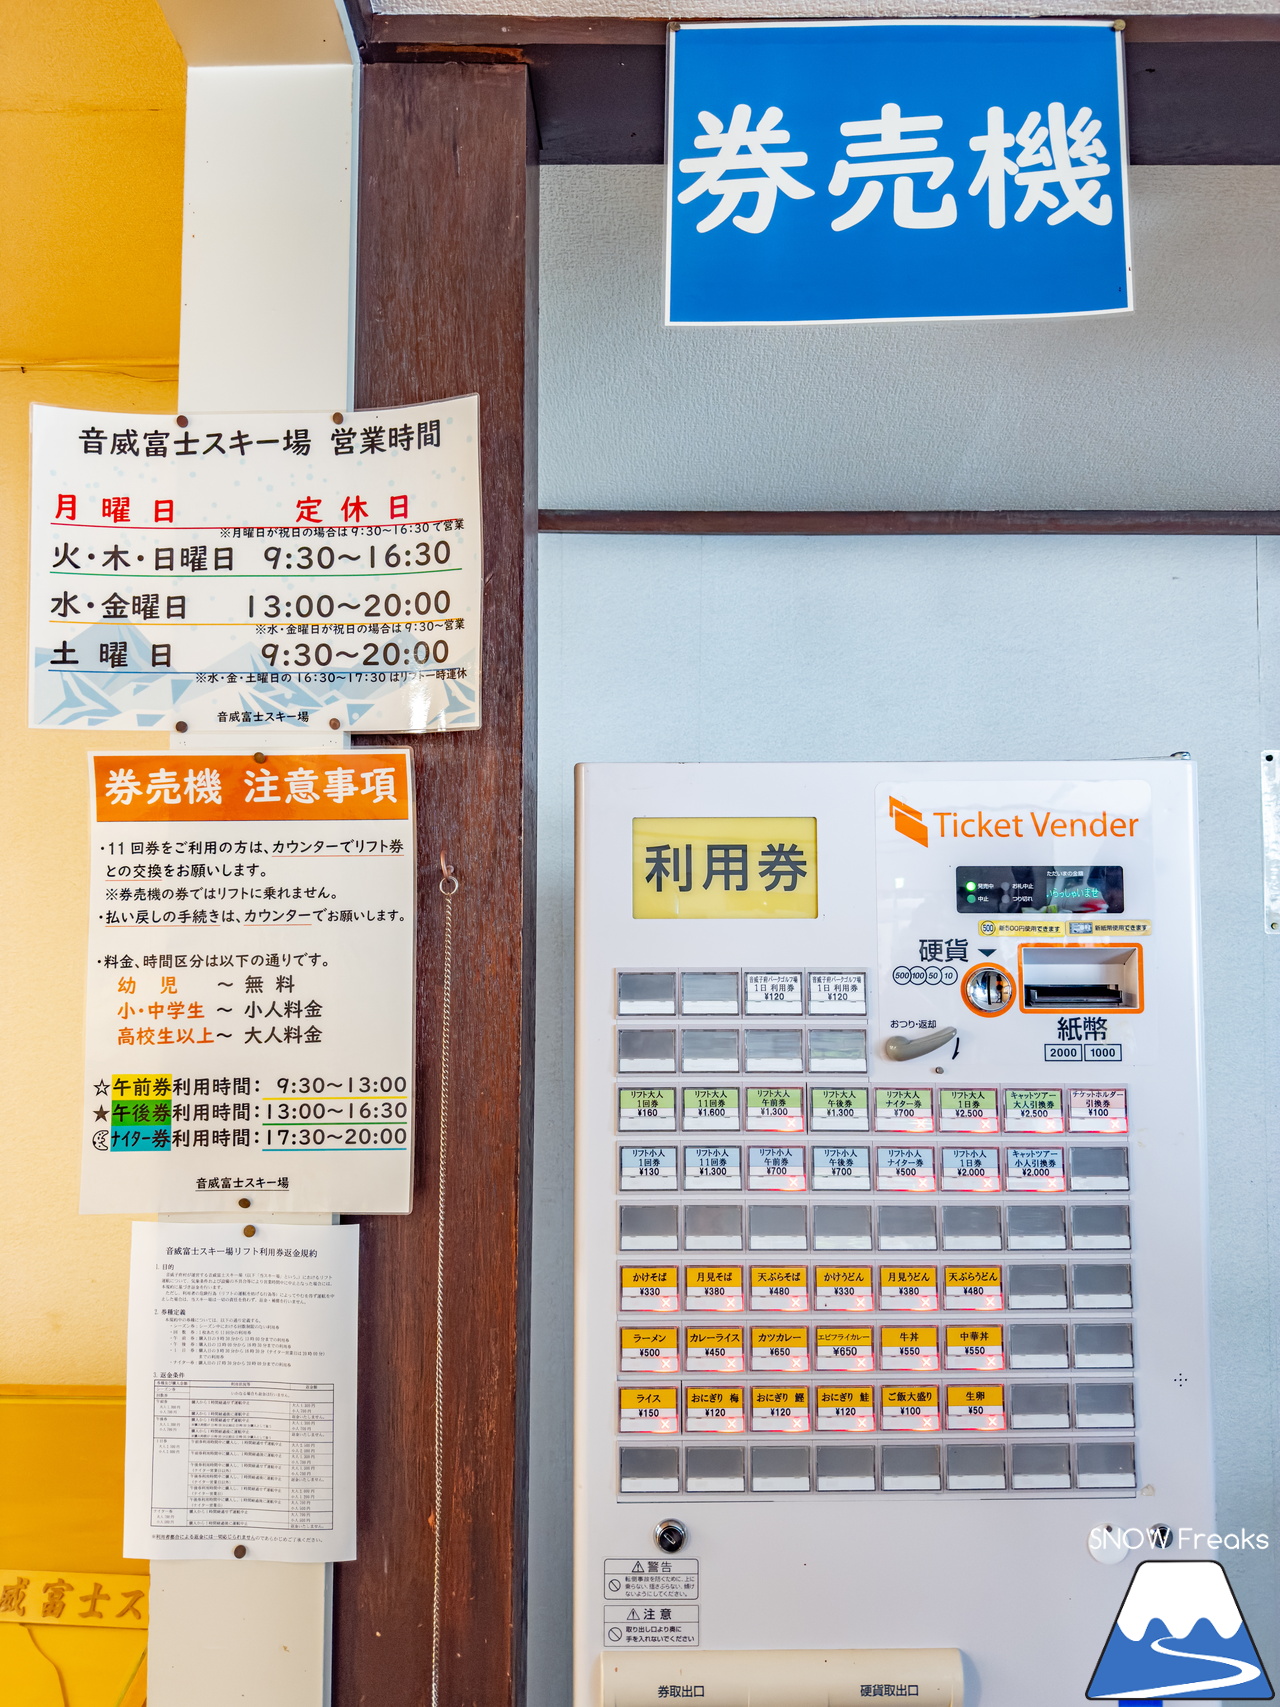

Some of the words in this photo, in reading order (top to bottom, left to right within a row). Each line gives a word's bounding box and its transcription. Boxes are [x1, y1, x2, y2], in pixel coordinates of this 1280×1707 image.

[678, 102, 1112, 233] 券売機
[79, 426, 311, 457] 音威富士スキー場
[331, 419, 441, 456] 営業時間
[248, 590, 451, 618] 13:00～20:00
[217, 711, 309, 723] 音威富士スキー場
[105, 767, 222, 805] 券売機
[243, 767, 398, 804] 注意事項
[933, 811, 1023, 837] Ticket
[1030, 811, 1139, 837] Vender
[105, 864, 267, 878] との交換をお願いします。
[645, 843, 807, 892] 利用券
[919, 938, 968, 962] 硬貨
[765, 993, 784, 1001] ¥120
[828, 993, 847, 1001] ¥120
[244, 999, 323, 1018] 小人料金
[1057, 1016, 1108, 1041] 紙幣
[244, 1025, 323, 1044] 大人料金
[1050, 1048, 1077, 1057] 2000
[1091, 1048, 1116, 1057] 1000
[631, 1091, 663, 1099] リフト大人
[695, 1091, 727, 1099] リフト大人
[757, 1090, 790, 1098] リフト大人
[823, 1090, 856, 1098] リフト大人
[886, 1091, 920, 1099] リフト大人
[952, 1091, 984, 1099] リフト大人
[1072, 1091, 1123, 1099] チケットホルダー
[638, 1099, 658, 1107] 1回券
[699, 1099, 722, 1107] 11回券
[762, 1099, 785, 1107] 午前券
[828, 1099, 852, 1107] 午後券
[886, 1100, 921, 1108] ナイター券
[959, 1100, 980, 1108] 1日券
[1013, 1100, 1054, 1109] 大人引換券
[1086, 1099, 1110, 1107] 引換券
[638, 1108, 657, 1116] ¥160
[894, 1109, 914, 1117] ¥700
[1089, 1108, 1108, 1116] ¥100
[633, 1149, 665, 1157] リフト小人
[696, 1149, 729, 1157] リフト小人
[759, 1149, 792, 1157] リフト小人
[824, 1149, 857, 1157] リフト小人
[889, 1150, 921, 1158] リフト小人
[954, 1150, 986, 1158] リフト小人
[1013, 1150, 1057, 1158] キャットツアー
[639, 1158, 660, 1166] 1回券
[700, 1158, 723, 1166] 11回券
[764, 1157, 788, 1165] 午前券
[829, 1158, 853, 1166] 午後券
[888, 1159, 923, 1167] ナイター券
[960, 1159, 982, 1167] 1日券
[1015, 1159, 1056, 1167] 小人引換券
[640, 1167, 659, 1175] ¥130
[832, 1167, 852, 1175] ¥700
[896, 1168, 916, 1176] ¥500
[195, 1177, 289, 1189] 音威富士スキー場
[633, 1272, 667, 1282] かけそば
[697, 1272, 732, 1282] 月見そば
[824, 1272, 864, 1282] かけうどん
[888, 1272, 930, 1282] 月見うどん
[640, 1288, 660, 1296] ¥330
[705, 1288, 725, 1296] ¥380
[769, 1288, 789, 1296] ¥480
[834, 1287, 854, 1295] ¥330
[899, 1287, 919, 1295] ¥380
[964, 1287, 983, 1295] ¥480
[633, 1333, 666, 1343] ラーメン
[690, 1333, 740, 1343] カレーライス
[758, 1333, 801, 1343] カツカレー
[900, 1332, 918, 1341] 牛丼
[960, 1332, 988, 1341] 中華丼
[640, 1348, 660, 1357] ¥500
[705, 1348, 725, 1357] ¥450
[770, 1348, 790, 1357] ¥650
[833, 1347, 857, 1356] ¥650
[900, 1347, 920, 1355] ¥550
[965, 1346, 985, 1355] ¥550
[637, 1394, 661, 1403] ライス
[692, 1393, 722, 1403] おにぎり
[730, 1393, 739, 1403] 梅
[757, 1393, 788, 1403] おにぎり
[822, 1392, 853, 1402] おにぎり
[860, 1392, 869, 1402] 鮭
[888, 1392, 932, 1401] ご飯大盛り
[966, 1392, 985, 1401] 生卵
[639, 1409, 659, 1417] ¥150
[705, 1408, 725, 1417] ¥120
[771, 1408, 791, 1417] ¥120
[836, 1407, 856, 1415] ¥120
[900, 1407, 921, 1415] ¥100
[968, 1406, 983, 1414] ¥50
[648, 1561, 672, 1573] 警告
[643, 1608, 672, 1620] 注意
[657, 1685, 705, 1698] 券取出口
[860, 1684, 919, 1697] 硬貨取出口
